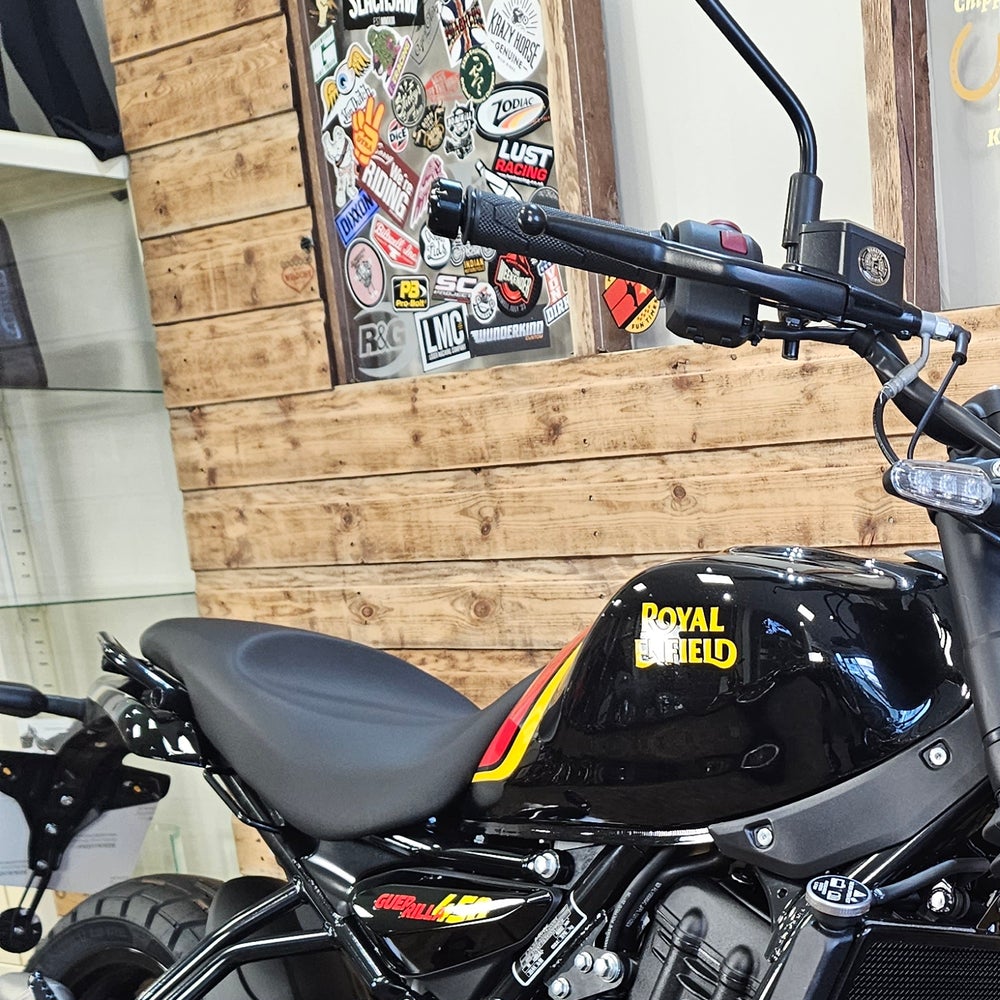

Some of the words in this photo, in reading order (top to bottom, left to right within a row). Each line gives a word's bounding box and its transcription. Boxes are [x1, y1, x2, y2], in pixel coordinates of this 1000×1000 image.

[488, 8, 517, 43] KRAZY
[513, 31, 541, 70] HORSE
[495, 42, 523, 69] GENUINE
[492, 97, 535, 127] ZODIAC
[499, 139, 553, 167] LUST
[495, 158, 548, 181] RACING
[362, 159, 411, 221] RIDING
[340, 194, 375, 236] DIXXON
[400, 279, 421, 299] PB
[435, 274, 478, 294] SC
[359, 318, 406, 357] R&G
[422, 309, 465, 354] LMC
[641, 602, 725, 632] ROYAL
